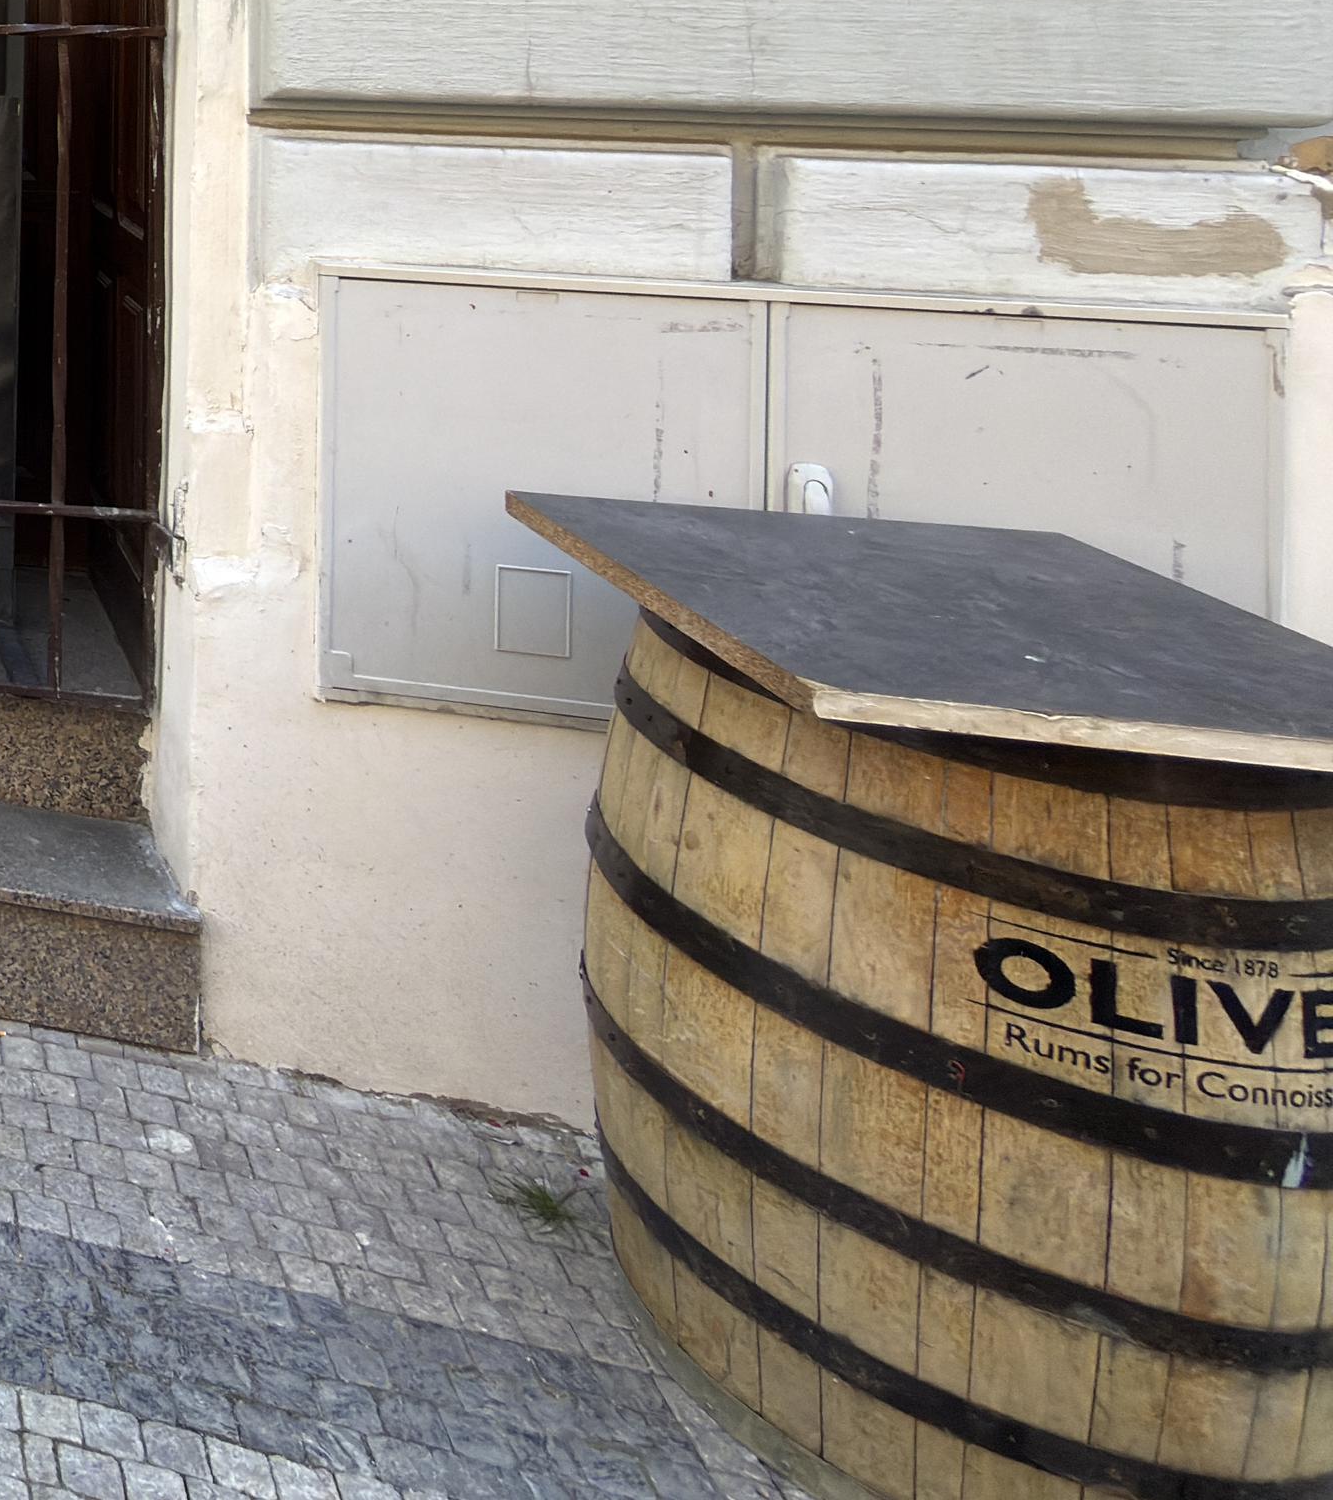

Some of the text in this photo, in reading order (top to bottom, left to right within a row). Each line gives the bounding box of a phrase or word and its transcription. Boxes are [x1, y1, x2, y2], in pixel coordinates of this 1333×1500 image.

[1166, 947, 1279, 979] Since 1878
[973, 937, 1333, 1059] OLIVE
[1004, 1021, 1111, 1075] Rums
[1126, 1056, 1182, 1088] for
